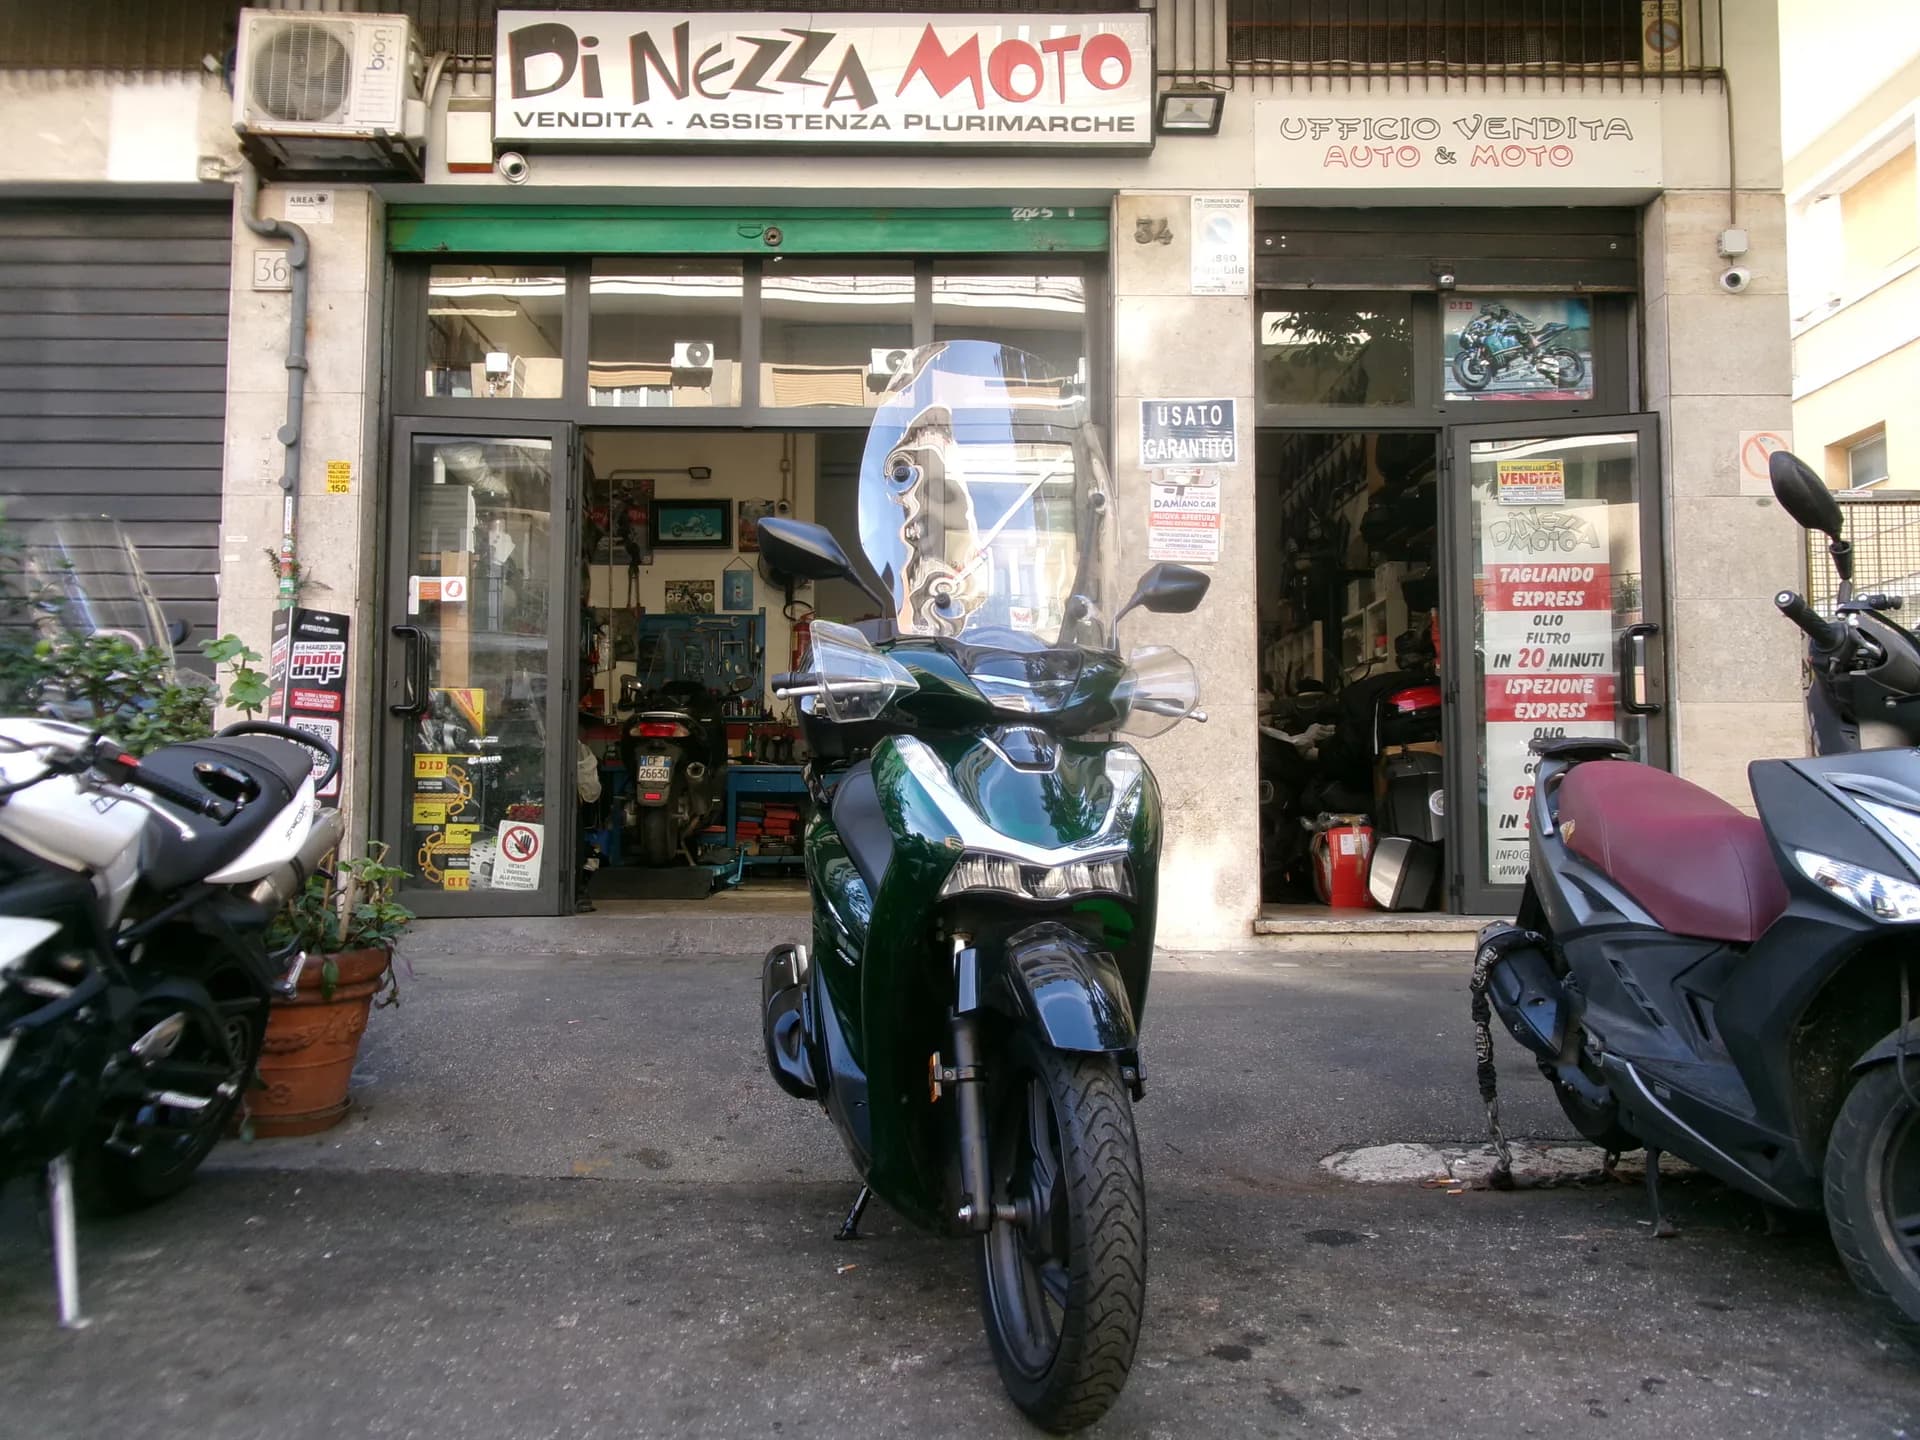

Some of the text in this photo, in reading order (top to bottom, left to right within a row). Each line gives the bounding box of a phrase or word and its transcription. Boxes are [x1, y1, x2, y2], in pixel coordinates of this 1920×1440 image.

[508, 22, 604, 100] Di
[895, 22, 1132, 110] MOTO
[514, 111, 653, 129] VENDITA
[686, 113, 891, 131] ASSISTENZA
[904, 114, 1136, 133] PLURIMARCHE
[1280, 114, 1634, 141] UFFICIO VENDITA
[1323, 144, 1574, 168] AUTO & MOTO
[290, 196, 314, 204] AREA
[256, 257, 287, 282] 36
[1157, 405, 1223, 426] USATO
[1145, 438, 1233, 459] GARANTITO
[1500, 472, 1562, 485] VENDITA
[1154, 499, 1217, 508] DAMIANO CAR
[1500, 567, 1594, 583] TAGLIANDO
[1512, 591, 1585, 607] EXPRESS
[1533, 615, 1563, 626] OLIO
[1526, 632, 1571, 644] FILTRO
[293, 651, 342, 665] moto
[1493, 648, 1605, 668] IN 20 MINUTI
[292, 664, 340, 681] days
[1505, 678, 1594, 695] ISPEZIONE
[1514, 702, 1588, 719] EXPRESS
[419, 761, 443, 770] DID
[1499, 815, 1518, 829] IN
